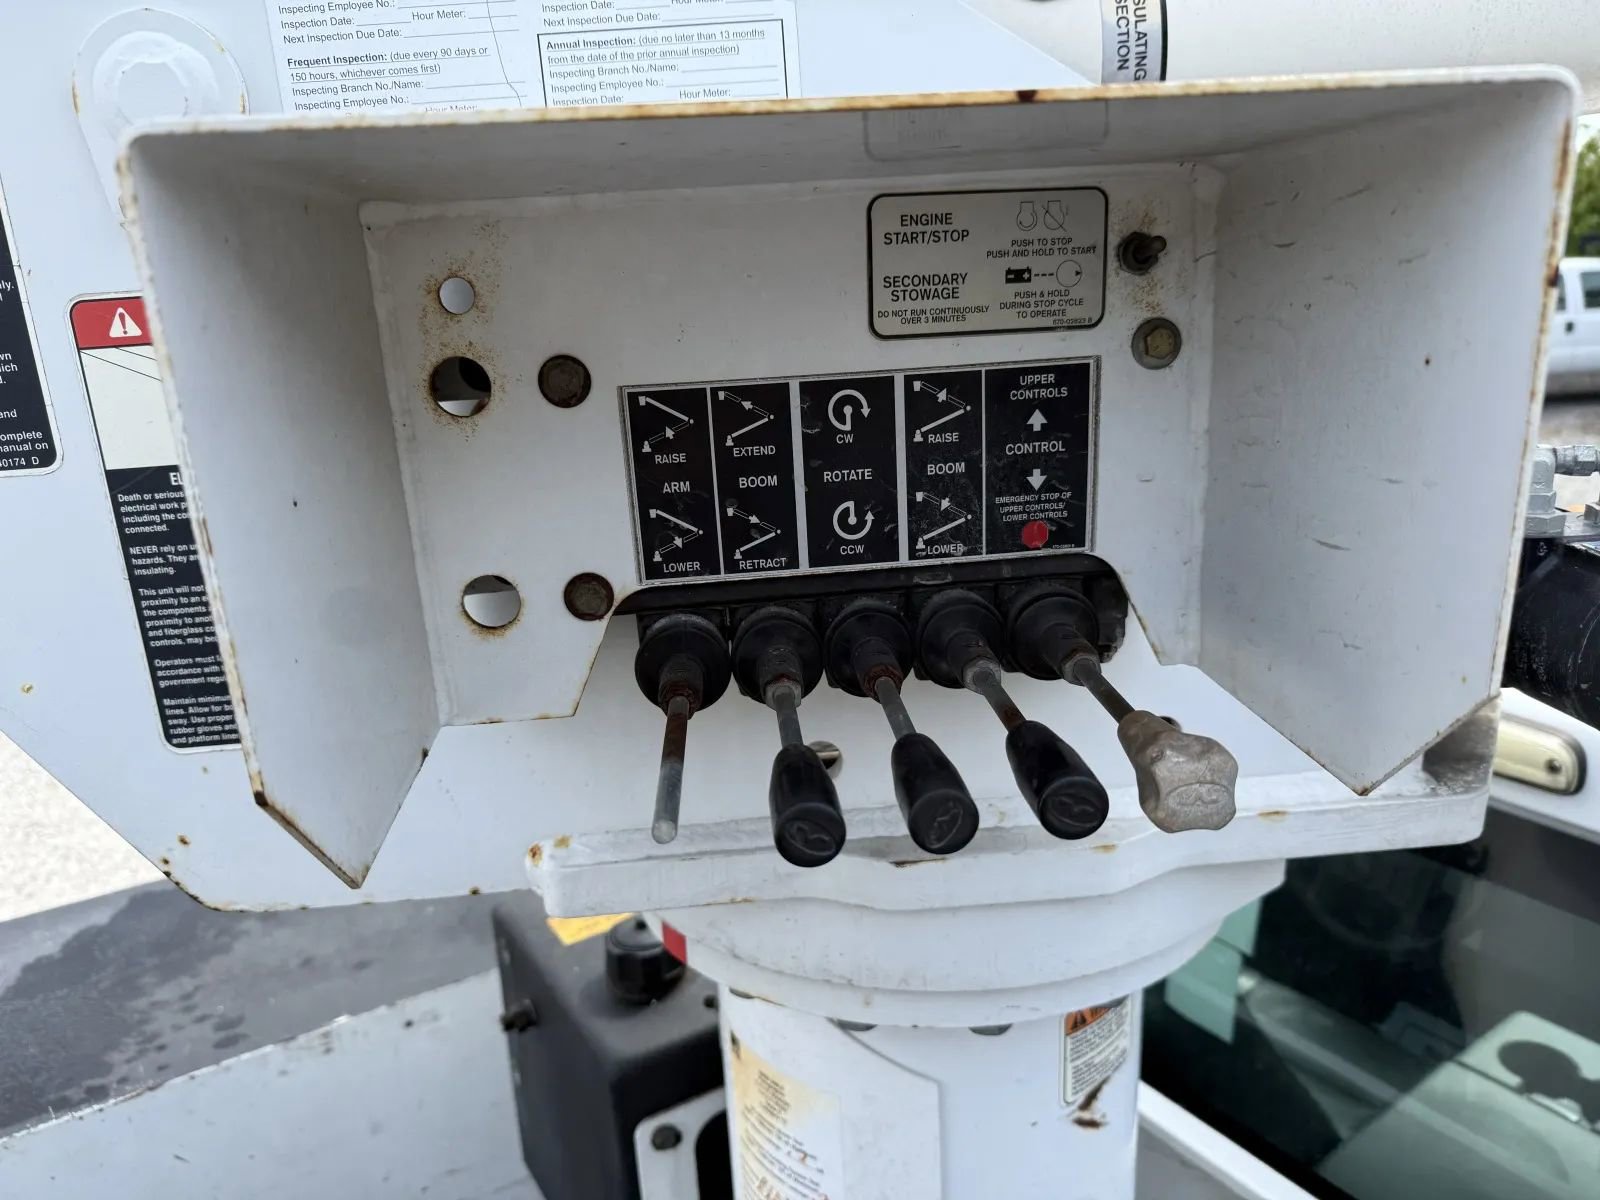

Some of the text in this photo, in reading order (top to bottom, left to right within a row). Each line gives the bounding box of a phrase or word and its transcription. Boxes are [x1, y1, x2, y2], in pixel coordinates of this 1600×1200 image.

[279, 5, 325, 15] Inspecting
[328, 1, 373, 11] Employee
[542, 0, 615, 13] Inspection Date:
[412, 10, 466, 20] Hour Meter:
[544, 12, 660, 27] Next Inspection Due Date:
[281, 17, 354, 30] Inspection Date:
[283, 29, 402, 44] Next Inspection Due Date:
[546, 40, 580, 50] Annual
[583, 37, 636, 48] Inspection:
[639, 35, 658, 45] (due
[675, 32, 695, 42] later
[697, 32, 716, 40] than
[720, 30, 730, 39] 13
[733, 29, 764, 38] months
[288, 56, 331, 68] Frequent
[334, 54, 387, 64] Inspection:
[391, 51, 411, 61] (due
[413, 50, 438, 59] every
[441, 48, 452, 56] 90
[455, 47, 476, 56] days
[547, 45, 740, 65] from the date of the prior annual inspection)
[291, 64, 440, 82] 150 hours, whichever comes first)
[550, 63, 679, 79] Inspecting Branch No./Name:
[292, 80, 423, 97] Inspecting Branch No./Name:
[551, 78, 664, 94] Inspecting Employee No.:
[600, 95, 624, 104] Date:
[679, 88, 731, 99] Hour Meter:
[295, 95, 409, 110] Inspecting Employee No.:
[900, 213, 953, 227] ENGINE
[884, 229, 970, 245] START/STOP
[1011, 239, 1033, 247] PUSH
[1050, 237, 1072, 245] STOP
[986, 250, 1009, 259] PUSH
[1012, 249, 1029, 257] AND
[1070, 246, 1096, 255] START
[883, 272, 968, 288] SECONDARY
[891, 287, 960, 302] STOWAGE
[1014, 291, 1036, 299] PUSH
[1047, 289, 1070, 297] HOLD
[1000, 298, 1084, 310] DURING STOP CYCLE
[877, 310, 889, 318] DO
[929, 305, 990, 315] CONTINUOUSLY
[1016, 309, 1067, 319] TO OPERATE
[931, 314, 966, 323] MINUTES
[1019, 374, 1056, 386] UPPER
[1010, 387, 1068, 401] CONTROLS
[0, 431, 43, 442] omplete
[836, 434, 854, 444] CW
[928, 432, 960, 444] RAISE
[733, 445, 776, 457] EXTEND
[1005, 441, 1066, 456] CONTROL
[654, 453, 686, 465] RAISE
[927, 462, 966, 476] BOOM
[823, 468, 872, 483] ROTATE
[663, 481, 690, 494] ARM
[739, 475, 778, 489] BOOM
[118, 493, 141, 502] Death
[995, 494, 1039, 504] EMERGENCY
[121, 503, 157, 512] electrical
[159, 502, 179, 510] work
[1000, 505, 1023, 513] UPPER
[123, 514, 160, 523] including
[1029, 511, 1068, 520] CONTROLS
[125, 524, 170, 534] connected.
[129, 546, 158, 554] NEVER
[160, 545, 175, 553] rely
[840, 545, 864, 555] CCW
[927, 544, 964, 555] LOWER
[132, 556, 166, 565] hazards.
[166, 555, 187, 563] They
[739, 557, 787, 570] RETRACT
[134, 566, 176, 575] insulating.
[663, 562, 700, 573] LOWER
